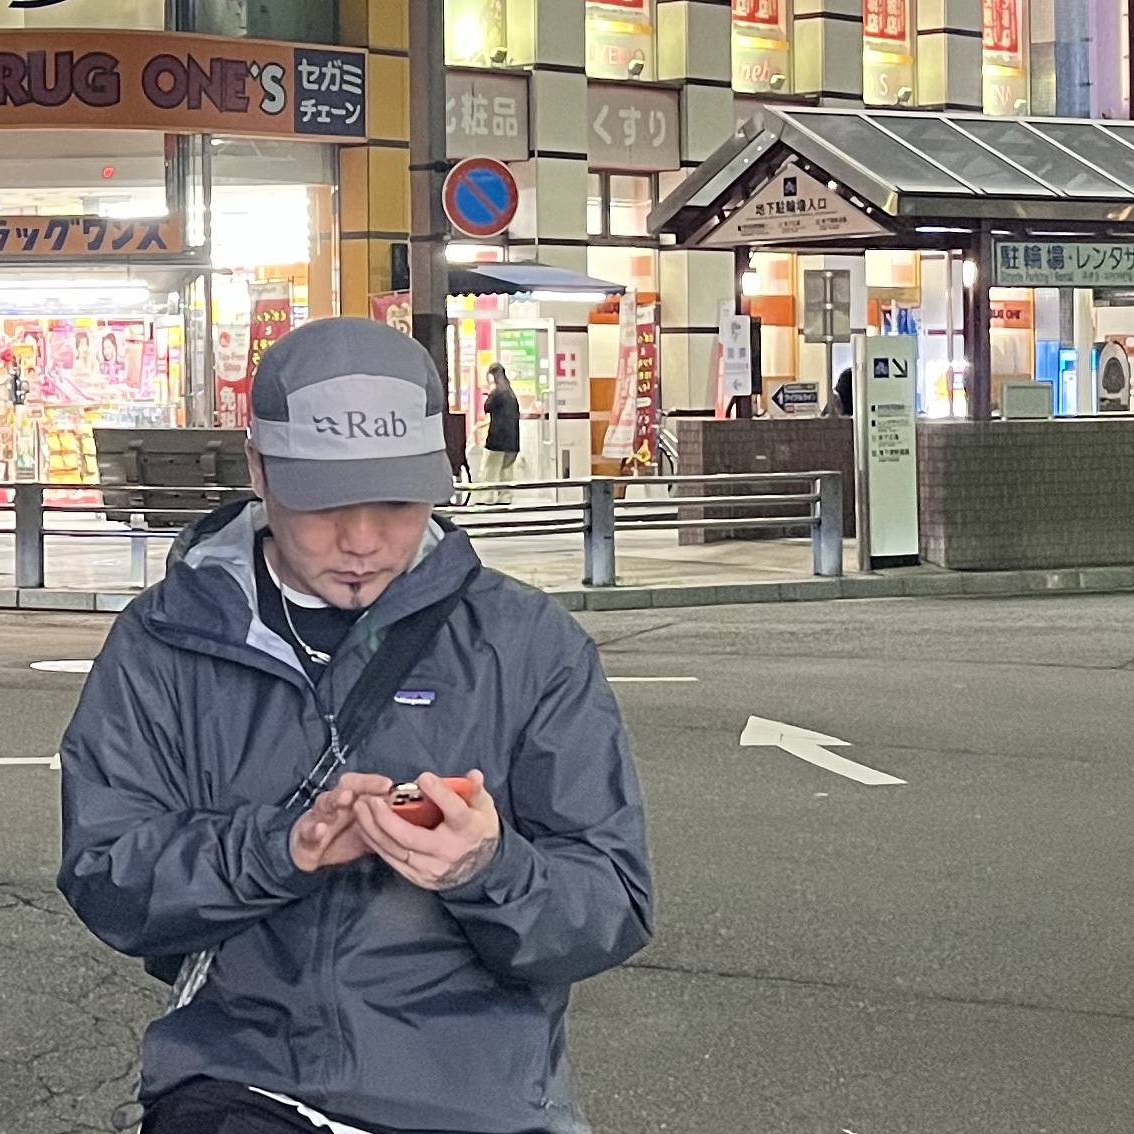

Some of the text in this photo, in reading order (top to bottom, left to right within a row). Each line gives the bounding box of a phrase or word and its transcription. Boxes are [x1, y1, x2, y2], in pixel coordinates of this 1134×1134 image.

[142, 53, 287, 115] ONE'S
[298, 58, 363, 95] セガミ
[299, 99, 361, 125] チェーン
[593, 104, 666, 147] くすり
[344, 410, 407, 439] Rab
